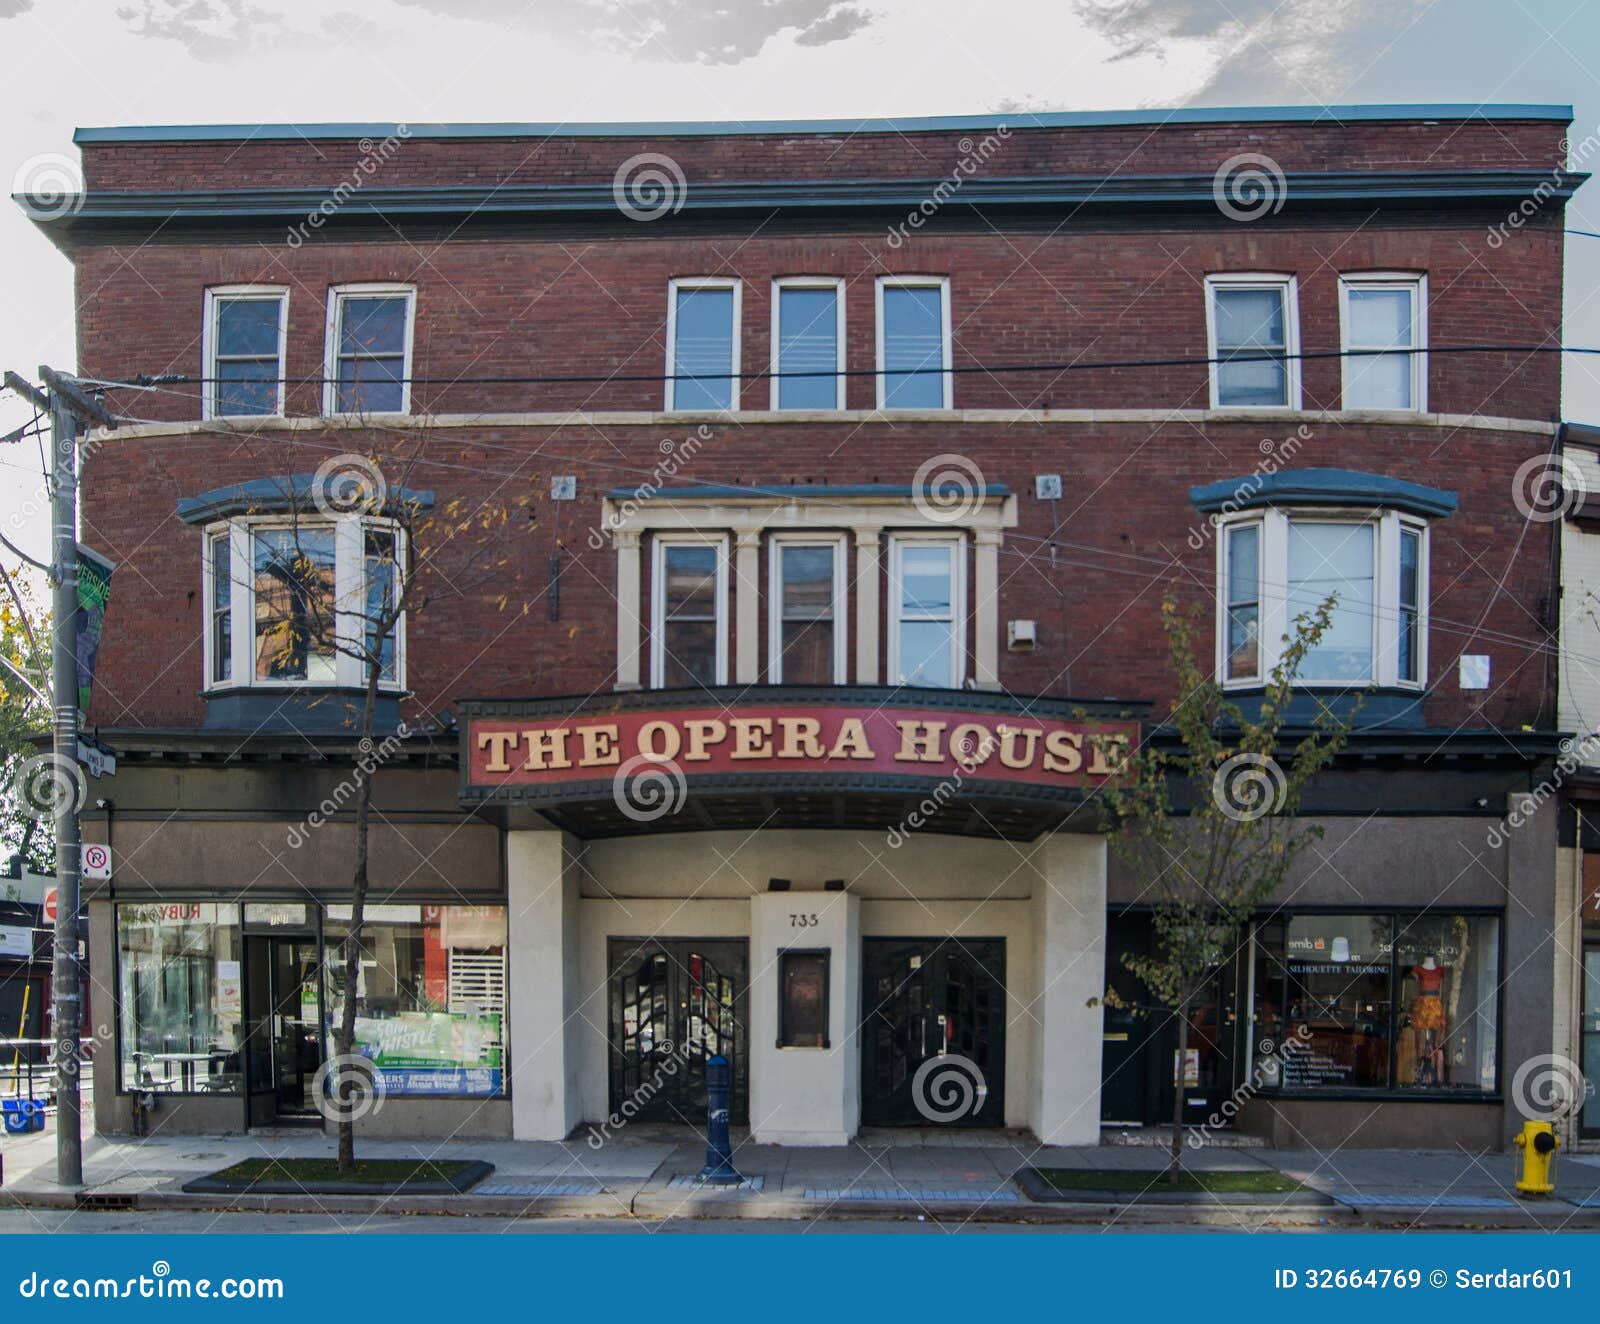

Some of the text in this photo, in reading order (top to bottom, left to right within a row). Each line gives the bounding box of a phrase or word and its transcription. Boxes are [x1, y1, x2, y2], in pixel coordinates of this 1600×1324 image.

[478, 716, 1130, 776] THE OPERA HOUSE
[789, 914, 819, 928] 735
[1289, 965, 1390, 975] SILHOUETTE TAILORING
